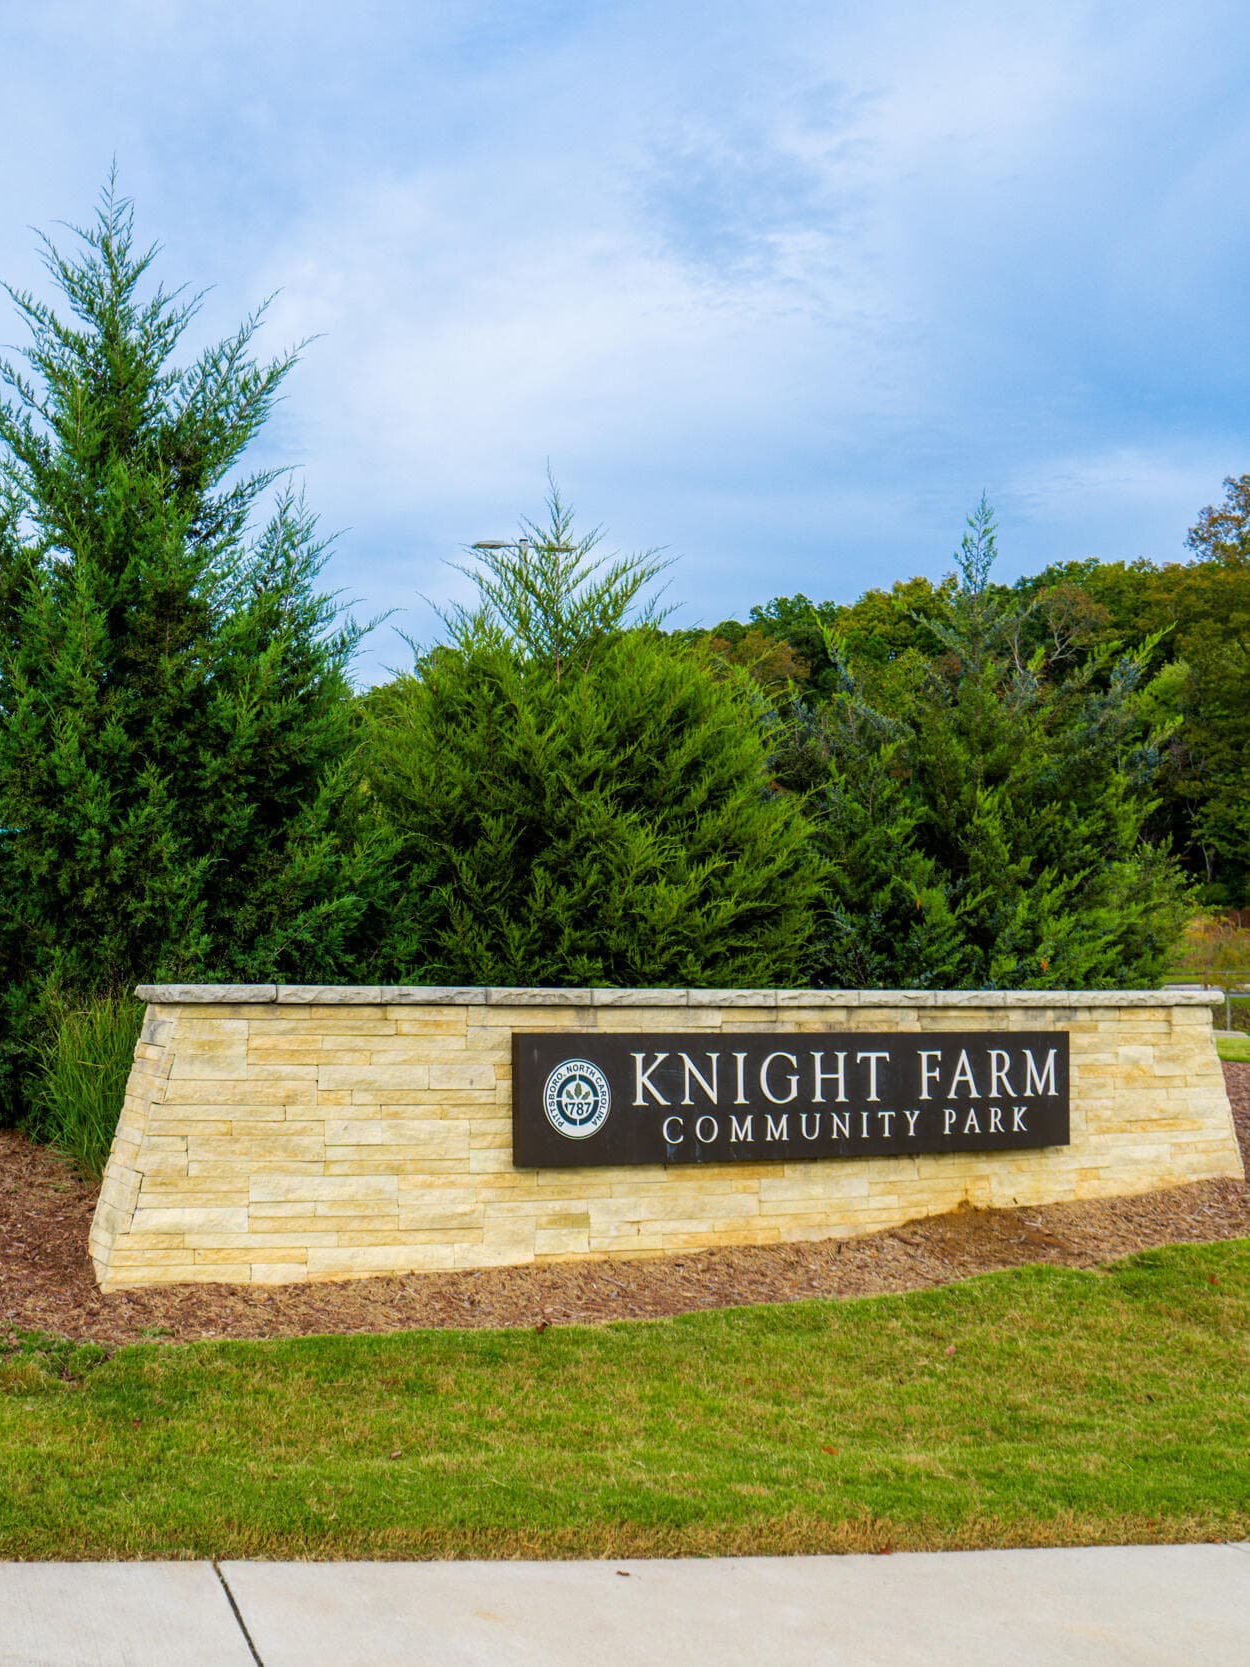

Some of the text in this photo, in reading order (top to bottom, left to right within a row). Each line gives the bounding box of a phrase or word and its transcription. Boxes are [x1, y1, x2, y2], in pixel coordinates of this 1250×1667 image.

[566, 1064, 596, 1078] NORTH
[591, 1076, 608, 1126] CAROLINA
[630, 1048, 1059, 1106] KNIGHT FARM
[564, 1102, 592, 1116] 1787
[662, 1106, 1028, 1144] COMMUNITY PARK
